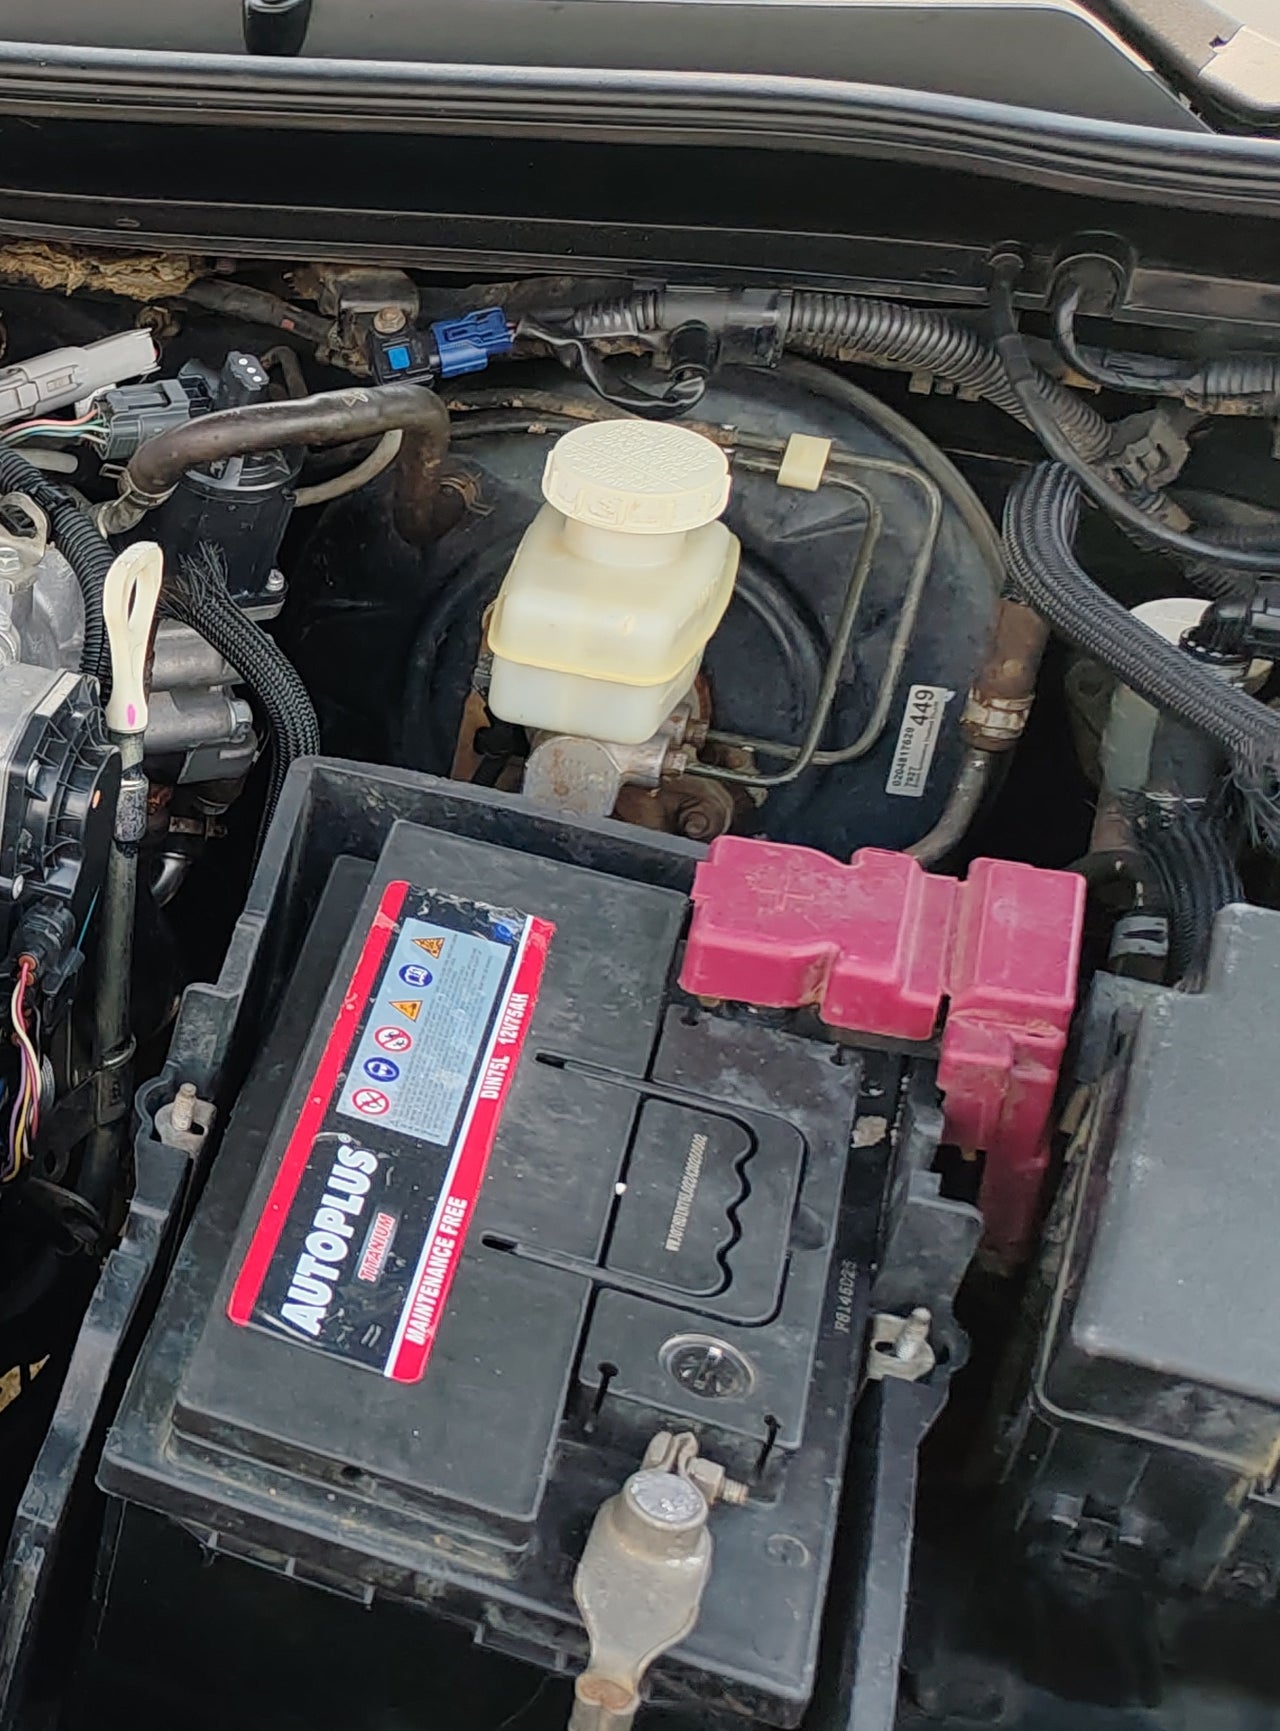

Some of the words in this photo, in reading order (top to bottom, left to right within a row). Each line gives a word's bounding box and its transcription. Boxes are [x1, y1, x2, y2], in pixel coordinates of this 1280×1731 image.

[910, 689, 935, 726] 449
[479, 1055, 511, 1100] DIN75L
[497, 992, 530, 1045] 12V75AH
[281, 1145, 378, 1336] AUTOPLUS
[357, 1212, 397, 1283] TITANIUM
[404, 1236, 456, 1346] MAINTENANCE
[439, 1195, 468, 1237] FREE
